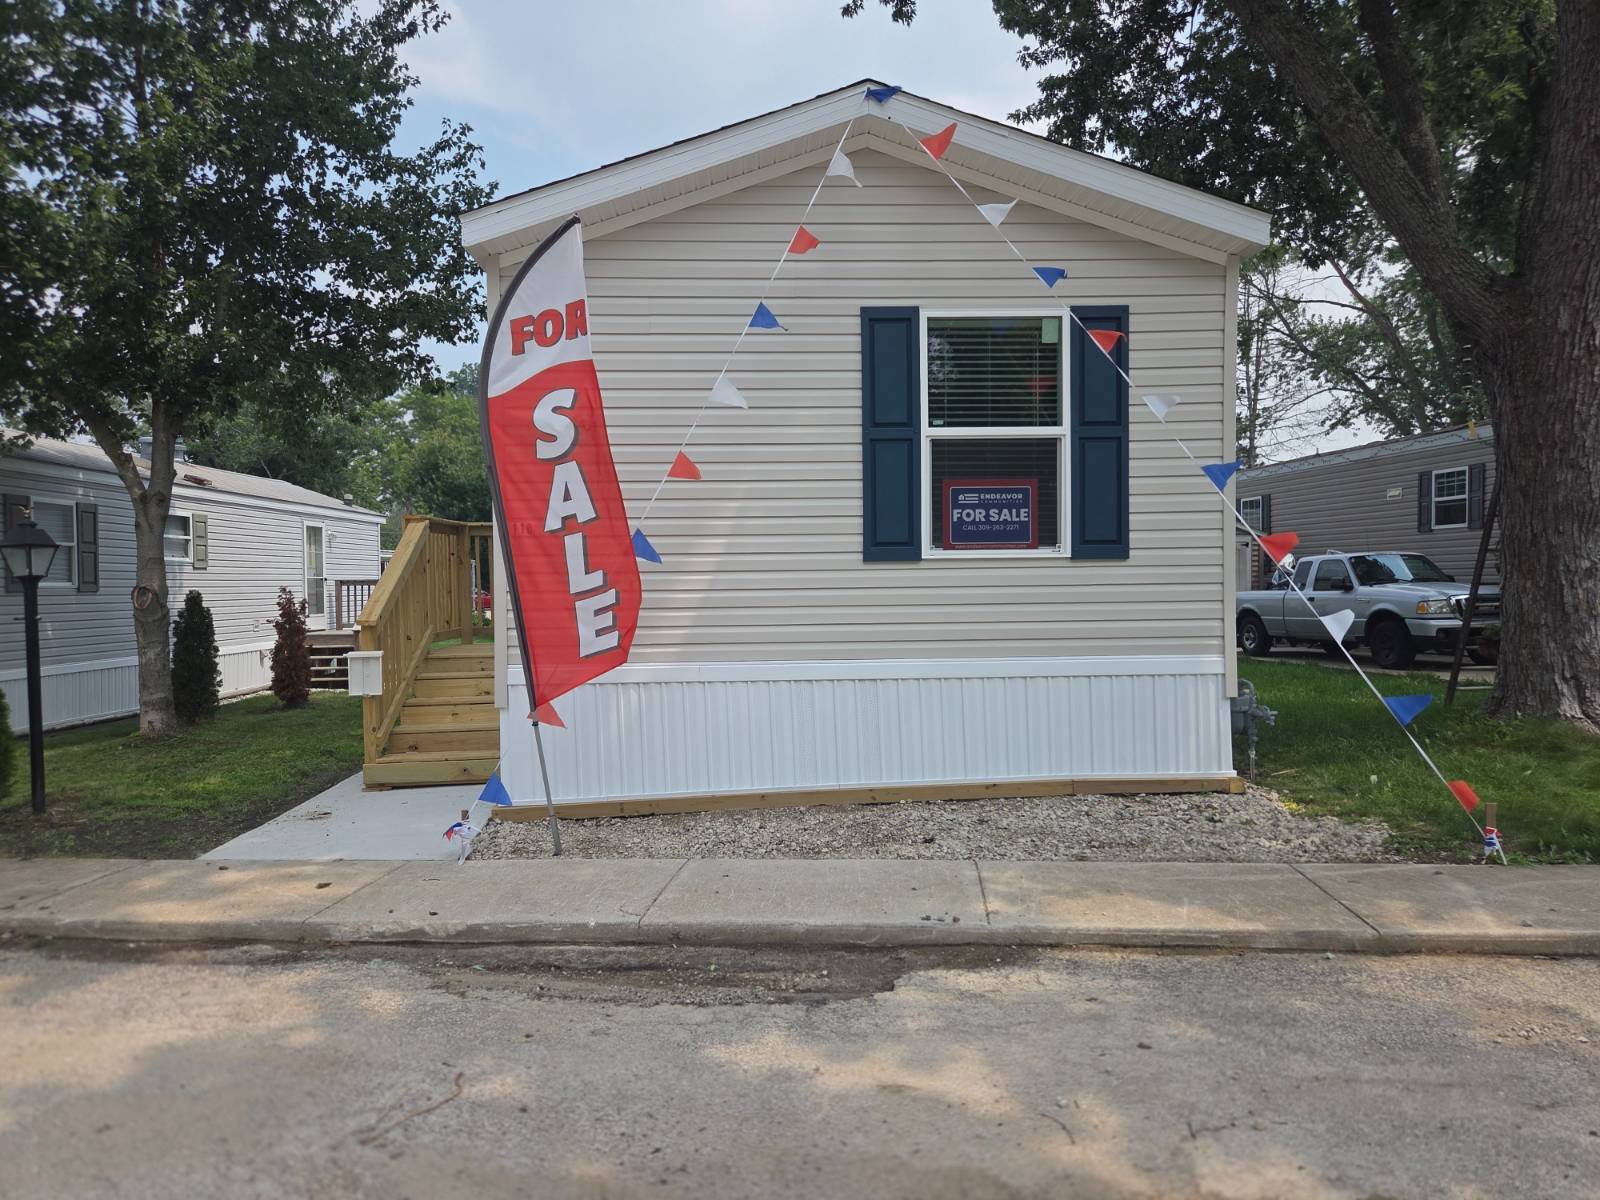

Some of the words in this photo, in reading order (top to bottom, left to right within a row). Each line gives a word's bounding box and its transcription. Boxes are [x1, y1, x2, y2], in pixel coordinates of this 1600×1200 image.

[510, 298, 588, 356] FOR
[532, 387, 621, 659] SALE
[952, 508, 986, 522] FOR
[989, 508, 1029, 522] SALE
